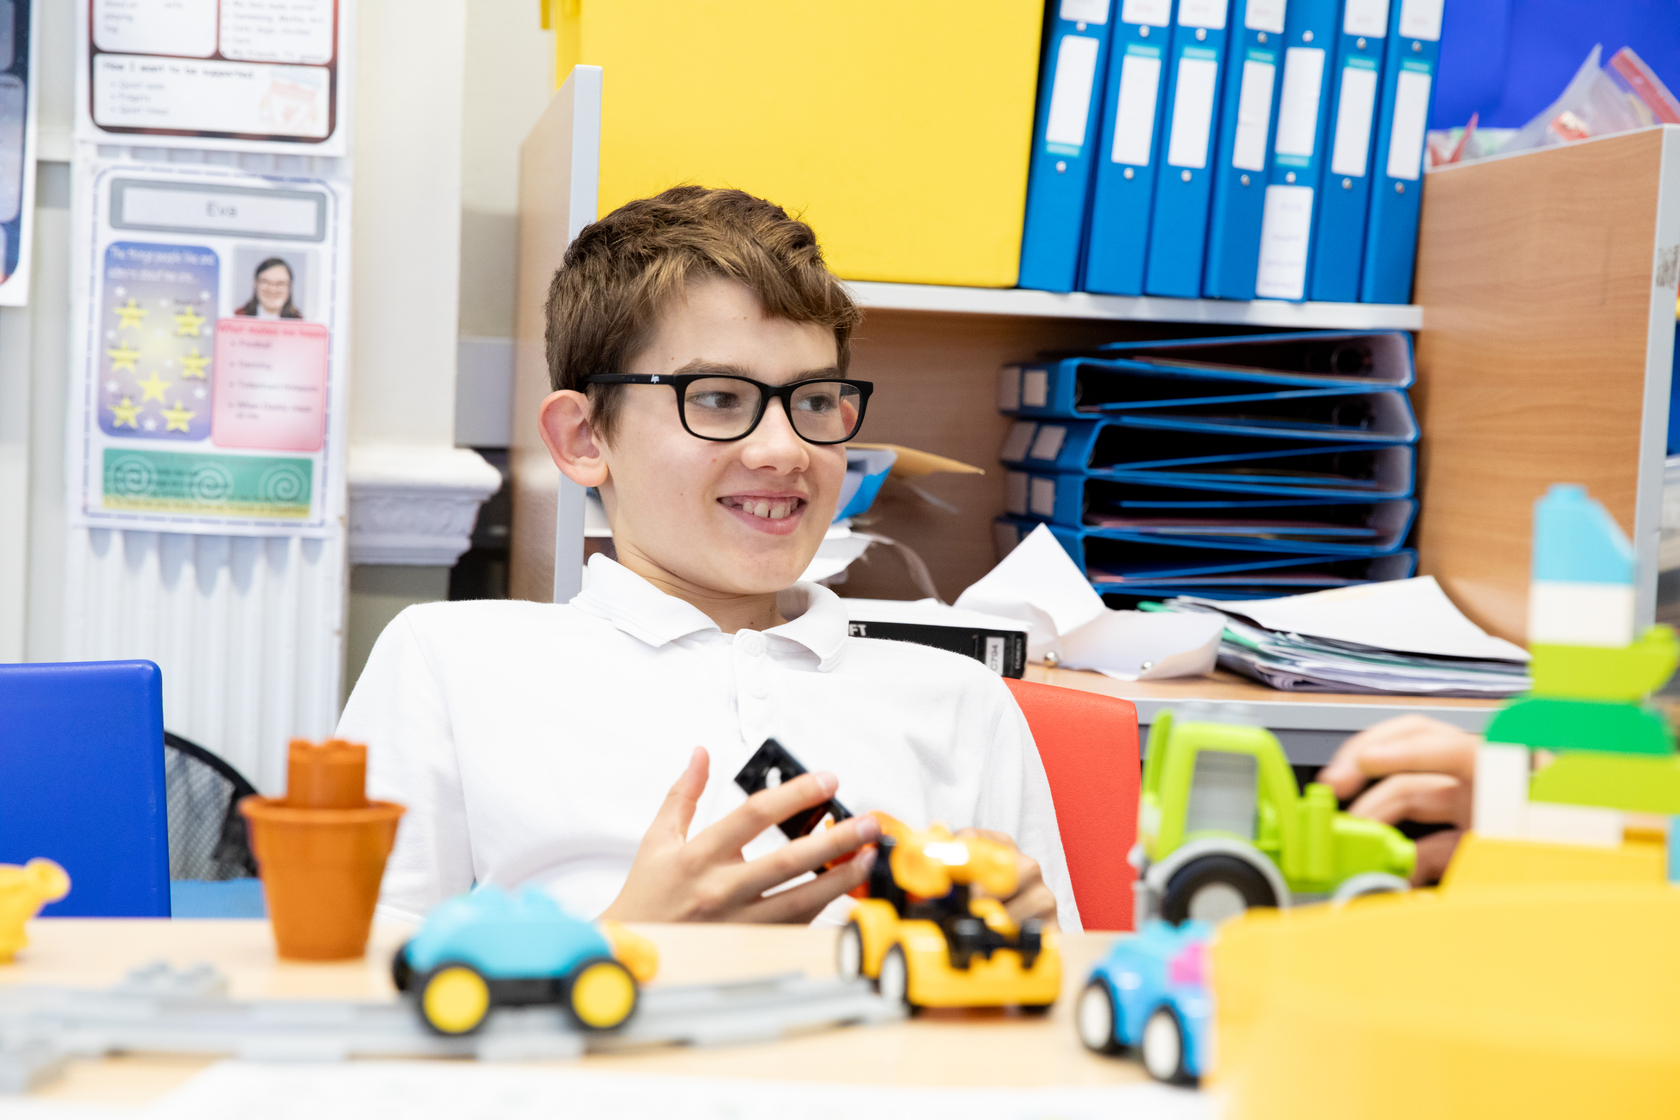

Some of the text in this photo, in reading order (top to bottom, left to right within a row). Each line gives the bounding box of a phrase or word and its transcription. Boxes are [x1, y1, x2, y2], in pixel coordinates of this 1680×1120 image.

[140, 63, 165, 73] want
[185, 65, 198, 75] be
[205, 201, 238, 219] Eva
[217, 323, 244, 335] What
[248, 326, 279, 337] makes
[282, 329, 296, 337] me
